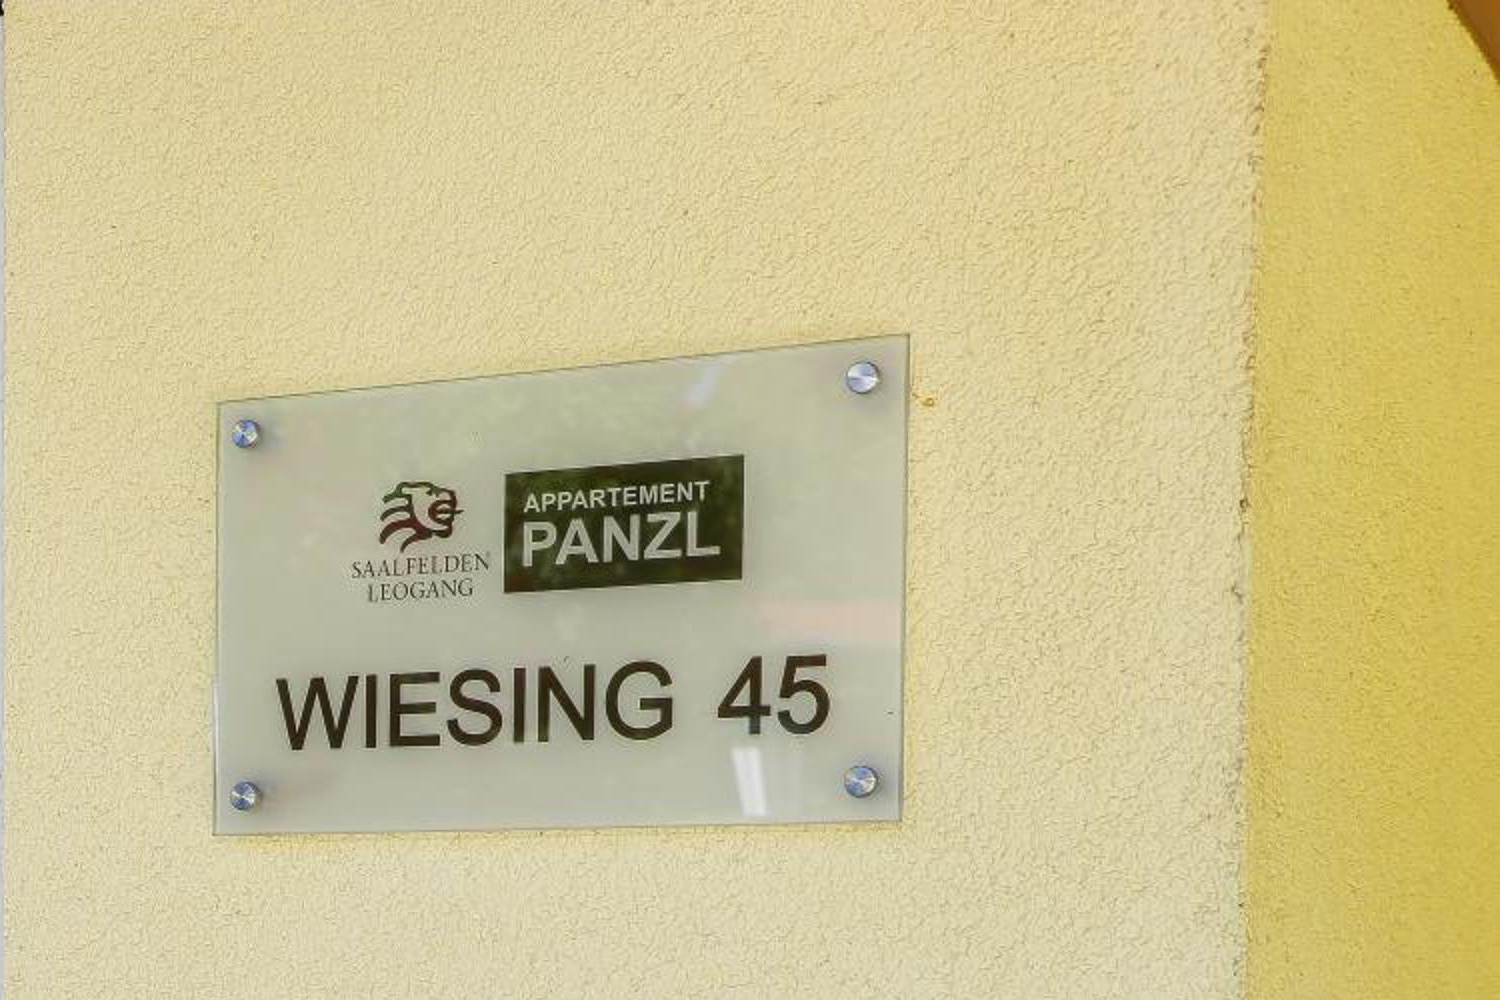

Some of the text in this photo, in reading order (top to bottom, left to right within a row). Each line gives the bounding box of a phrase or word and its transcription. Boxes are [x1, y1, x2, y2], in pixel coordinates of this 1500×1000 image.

[523, 480, 710, 513] APPARTEMENT
[521, 511, 721, 567] PANZL
[350, 553, 490, 579] SAALFELDEN
[367, 577, 475, 603] LEOGANG
[276, 654, 831, 751] WIESING 45
